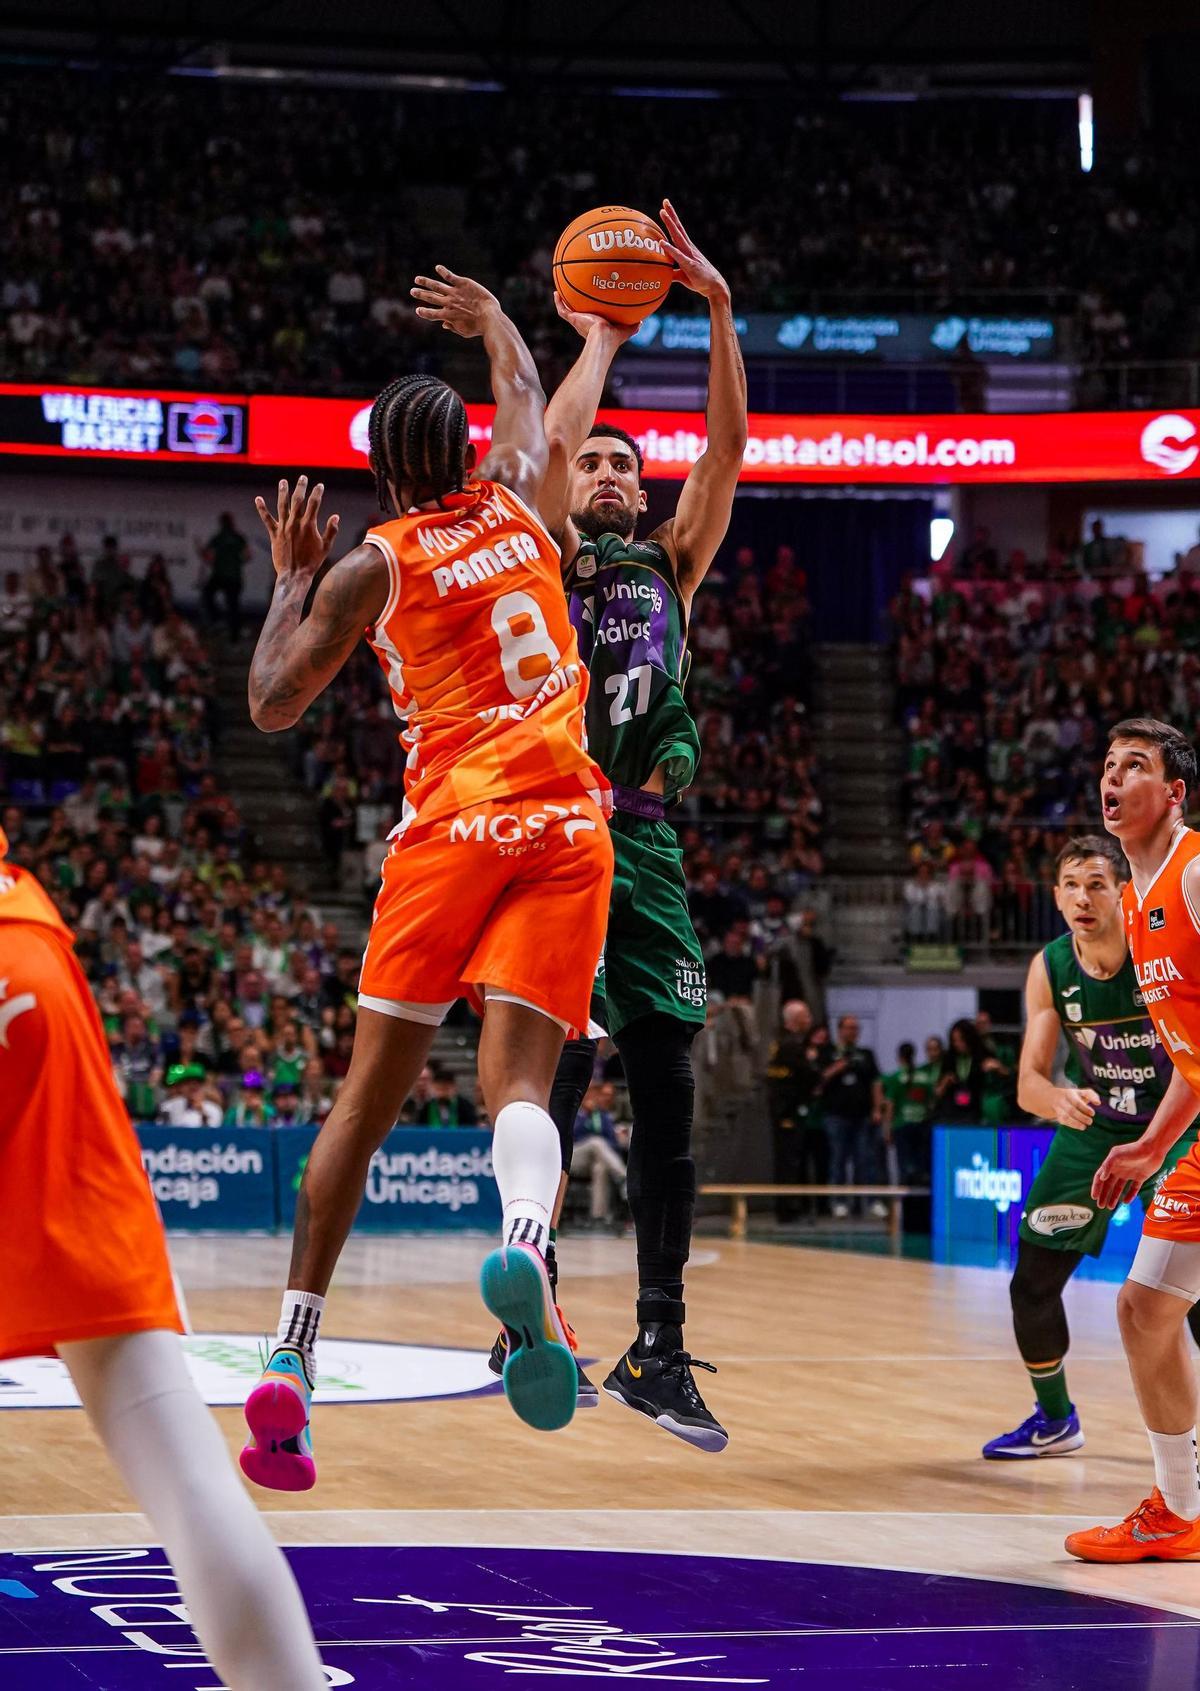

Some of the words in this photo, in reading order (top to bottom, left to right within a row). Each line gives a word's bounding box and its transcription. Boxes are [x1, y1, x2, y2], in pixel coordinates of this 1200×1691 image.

[588, 229, 666, 256] Wilson
[62, 421, 161, 452] BASKET
[432, 532, 541, 598] PAMESA
[491, 590, 561, 700] 8
[604, 664, 653, 726] 27
[450, 814, 548, 843] MGS
[141, 1143, 263, 1174] ndación
[365, 1176, 479, 1212] Unicaja
[1153, 1193, 1191, 1215] ULEVA
